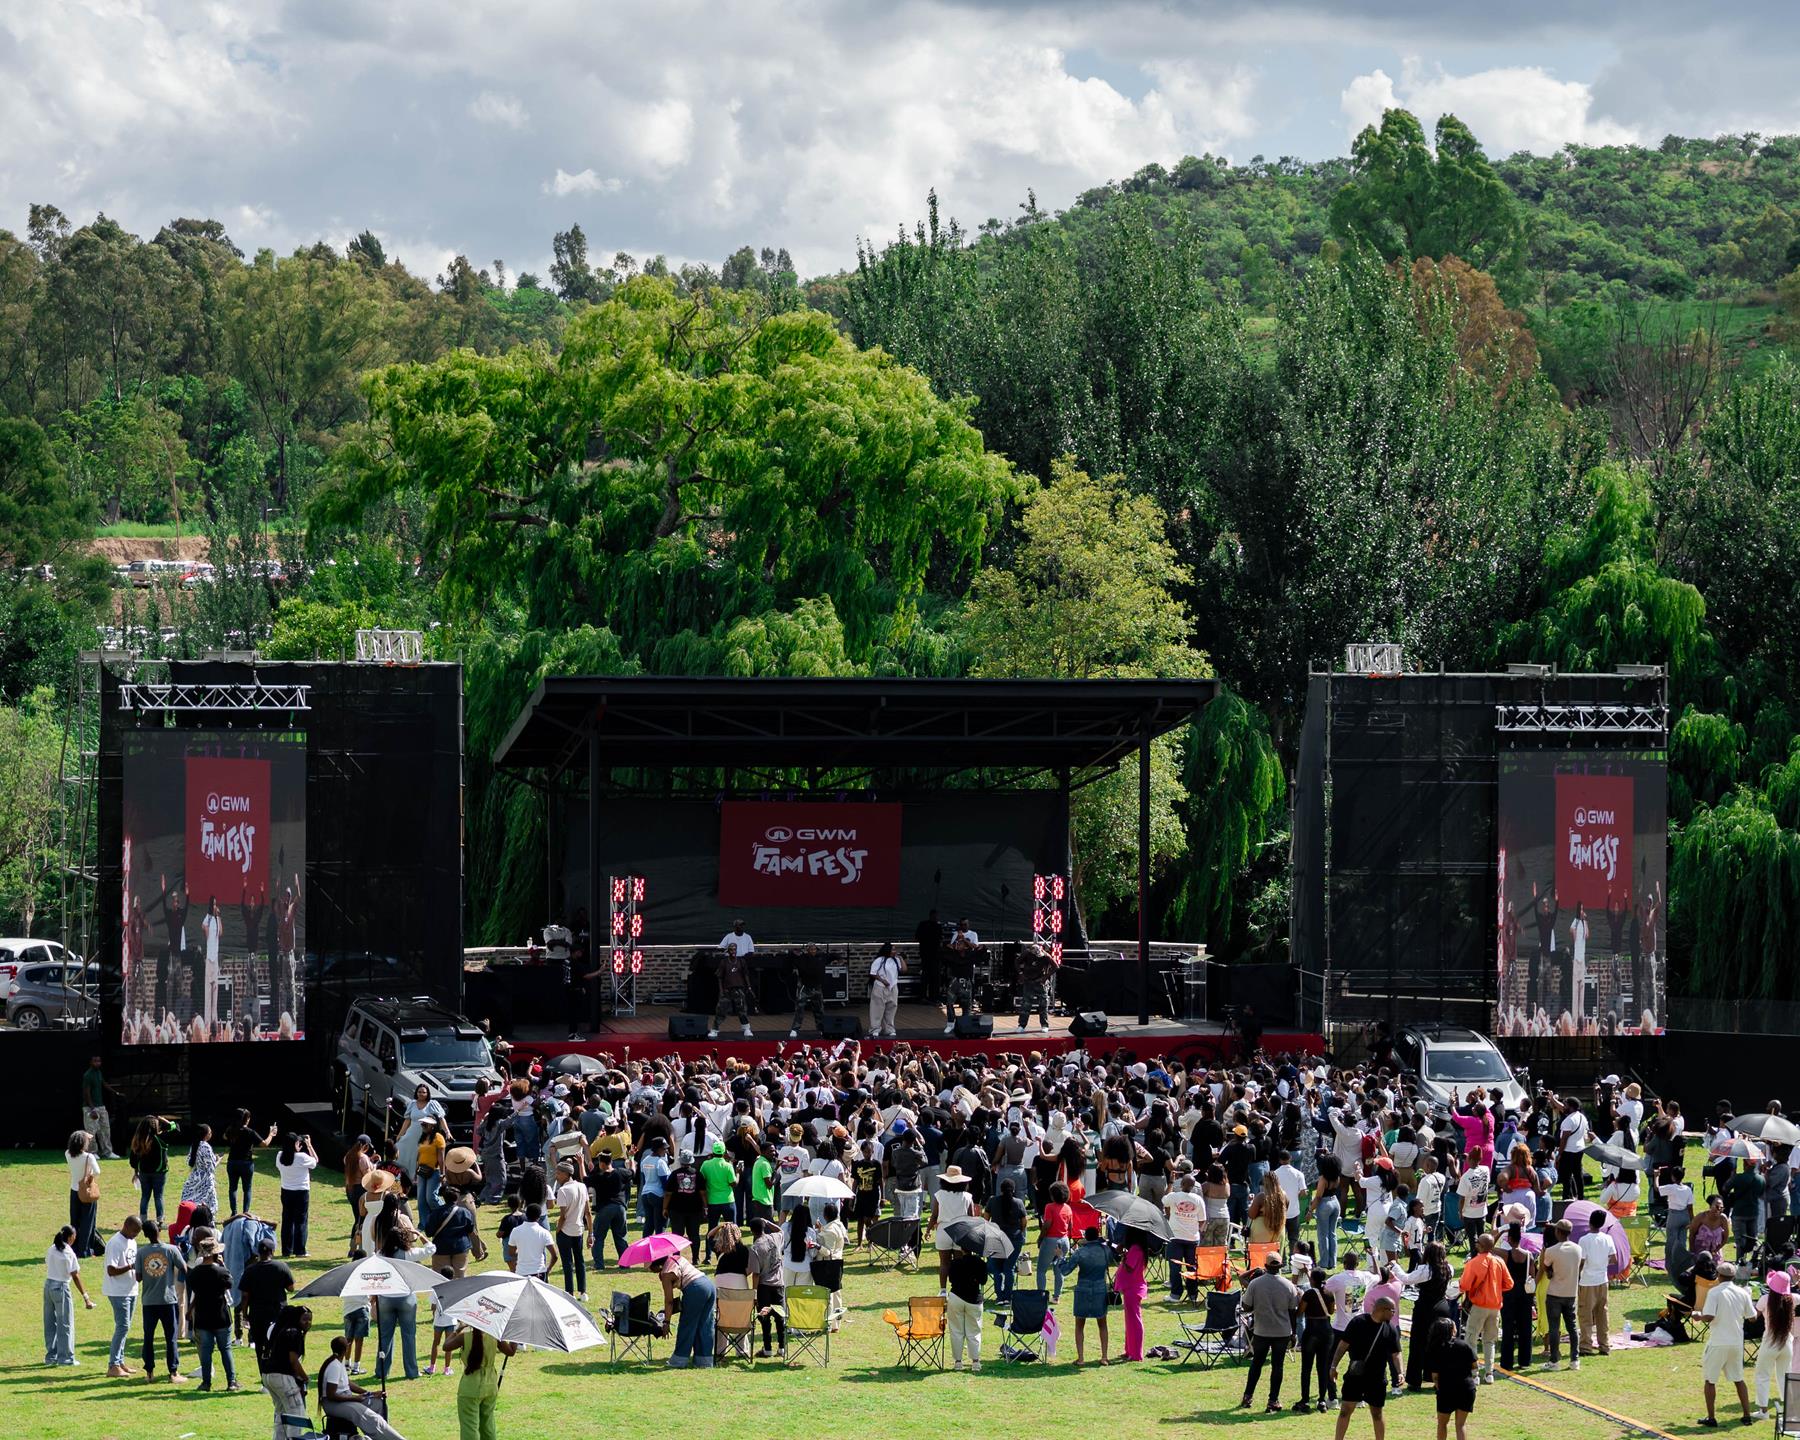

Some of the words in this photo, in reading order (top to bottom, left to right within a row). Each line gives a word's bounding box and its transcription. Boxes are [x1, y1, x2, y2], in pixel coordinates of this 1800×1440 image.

[221, 796, 249, 811] GWM
[1587, 810, 1614, 824] GWM
[797, 829, 856, 841] GWM
[808, 847, 868, 885] FEST
